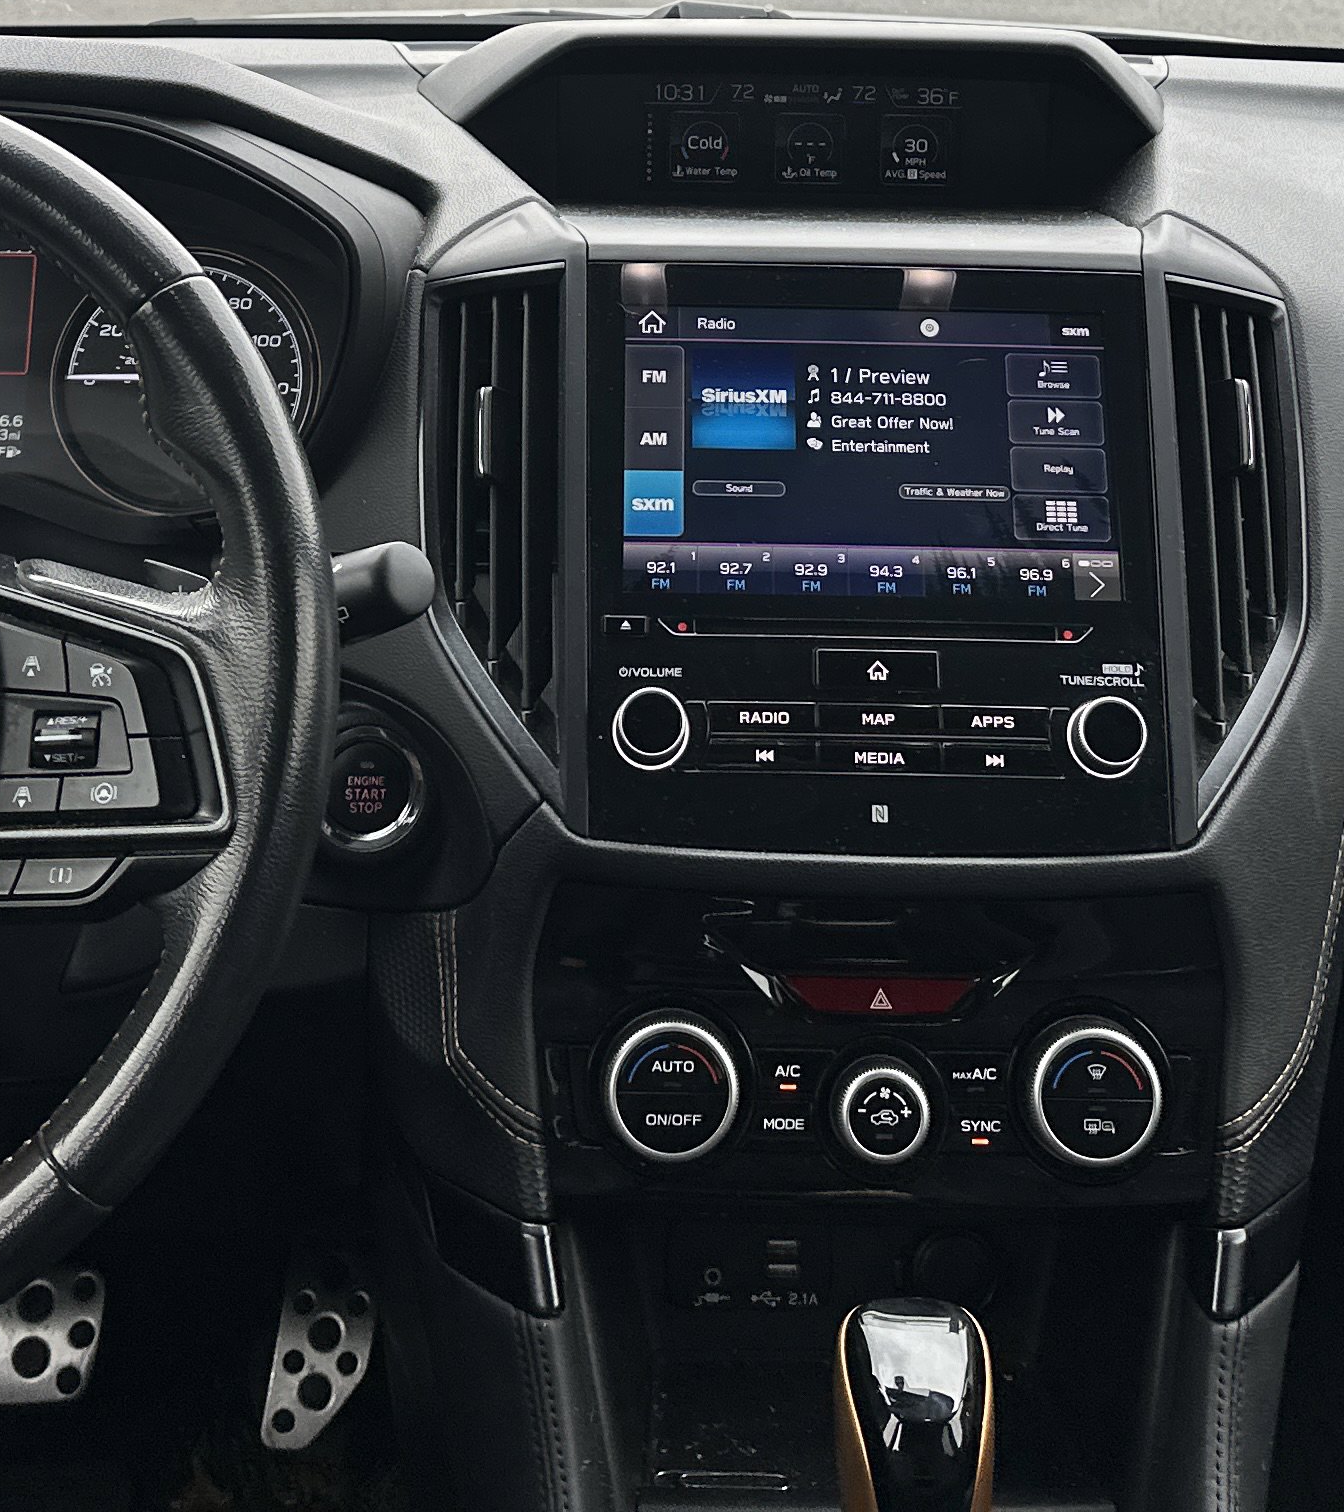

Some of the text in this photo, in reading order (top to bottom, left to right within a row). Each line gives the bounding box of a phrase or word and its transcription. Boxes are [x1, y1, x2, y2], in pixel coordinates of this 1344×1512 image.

[655, 84, 705, 102] 10:31
[730, 84, 755, 100] 72
[852, 85, 877, 101] 72
[687, 136, 723, 150] Cold
[905, 139, 928, 153] 30
[905, 157, 927, 167] MPH
[685, 167, 738, 178] Water Temp
[799, 168, 838, 179] Oil Temp
[919, 169, 947, 181] Speed
[697, 317, 736, 330] Radio
[1061, 327, 1090, 337] sxm
[251, 334, 282, 348] 100
[642, 370, 667, 383] FM
[830, 368, 838, 383] 1
[859, 368, 931, 385] Preview
[1037, 380, 1070, 390] Browse
[701, 388, 787, 404] SiriusXM
[830, 392, 947, 407] 844-711-8800
[831, 416, 954, 430] Great Offer Now!
[1033, 426, 1080, 436] Tune Scan
[640, 432, 668, 446] AM
[831, 440, 930, 454] Entertainment
[1043, 464, 1074, 475] Replay
[725, 483, 754, 493] Sound
[904, 487, 933, 497] Traffic
[946, 488, 983, 498] Weather
[985, 489, 1005, 498] Now
[631, 497, 675, 511] sxm
[1036, 523, 1089, 533] Direct Tune
[690, 551, 697, 561] 1
[762, 552, 771, 562] 2
[837, 553, 846, 563] 3
[911, 555, 920, 565] 4
[987, 556, 996, 567] 5
[1061, 557, 1070, 568] 6
[646, 561, 676, 574] 92.1
[719, 562, 753, 575] 92.7
[794, 564, 828, 576] 92.9
[869, 565, 903, 578] 94.3
[946, 566, 976, 579] 96.1
[1019, 568, 1053, 581] 96.9
[651, 578, 671, 589] FM
[726, 579, 746, 590] FM
[802, 580, 821, 592] FM
[877, 582, 896, 593] FM
[952, 583, 972, 595] FM
[1027, 585, 1047, 597] FM
[1059, 674, 1145, 688] TUNE/SCROLL
[739, 710, 790, 725] RADIO
[861, 712, 896, 726] MAP
[970, 715, 1015, 729] APPS
[854, 751, 906, 766] MEDIA
[347, 775, 385, 787] ENGINE
[344, 788, 387, 801] START
[349, 801, 383, 814] STOP
[651, 1060, 695, 1074] AUTO
[775, 1065, 801, 1079] A/C
[645, 1112, 703, 1127] ON/OFF
[763, 1117, 805, 1131] MODE
[961, 1119, 1001, 1133] SYNC
